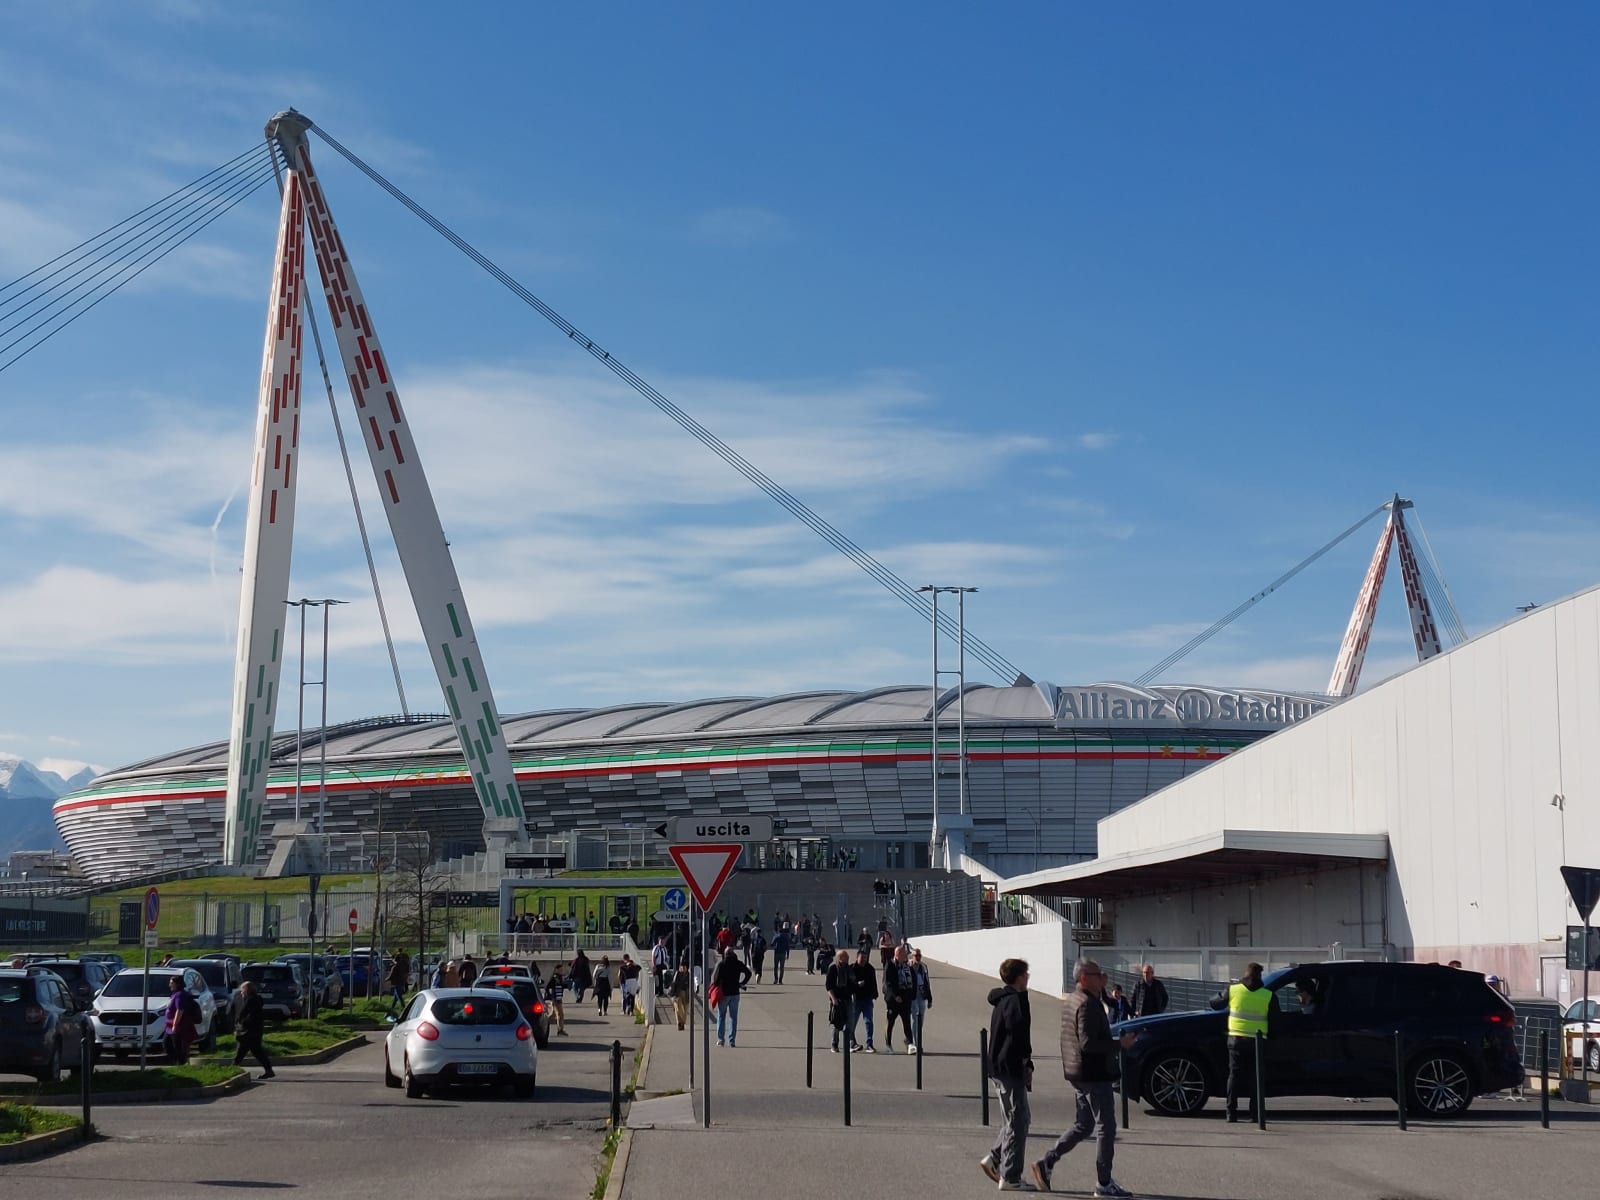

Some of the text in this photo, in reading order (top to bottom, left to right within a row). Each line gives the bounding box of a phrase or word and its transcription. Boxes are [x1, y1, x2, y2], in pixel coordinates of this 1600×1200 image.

[1059, 692, 1167, 720] Allianz
[696, 821, 751, 837] uscita
[665, 912, 688, 920] uscita
